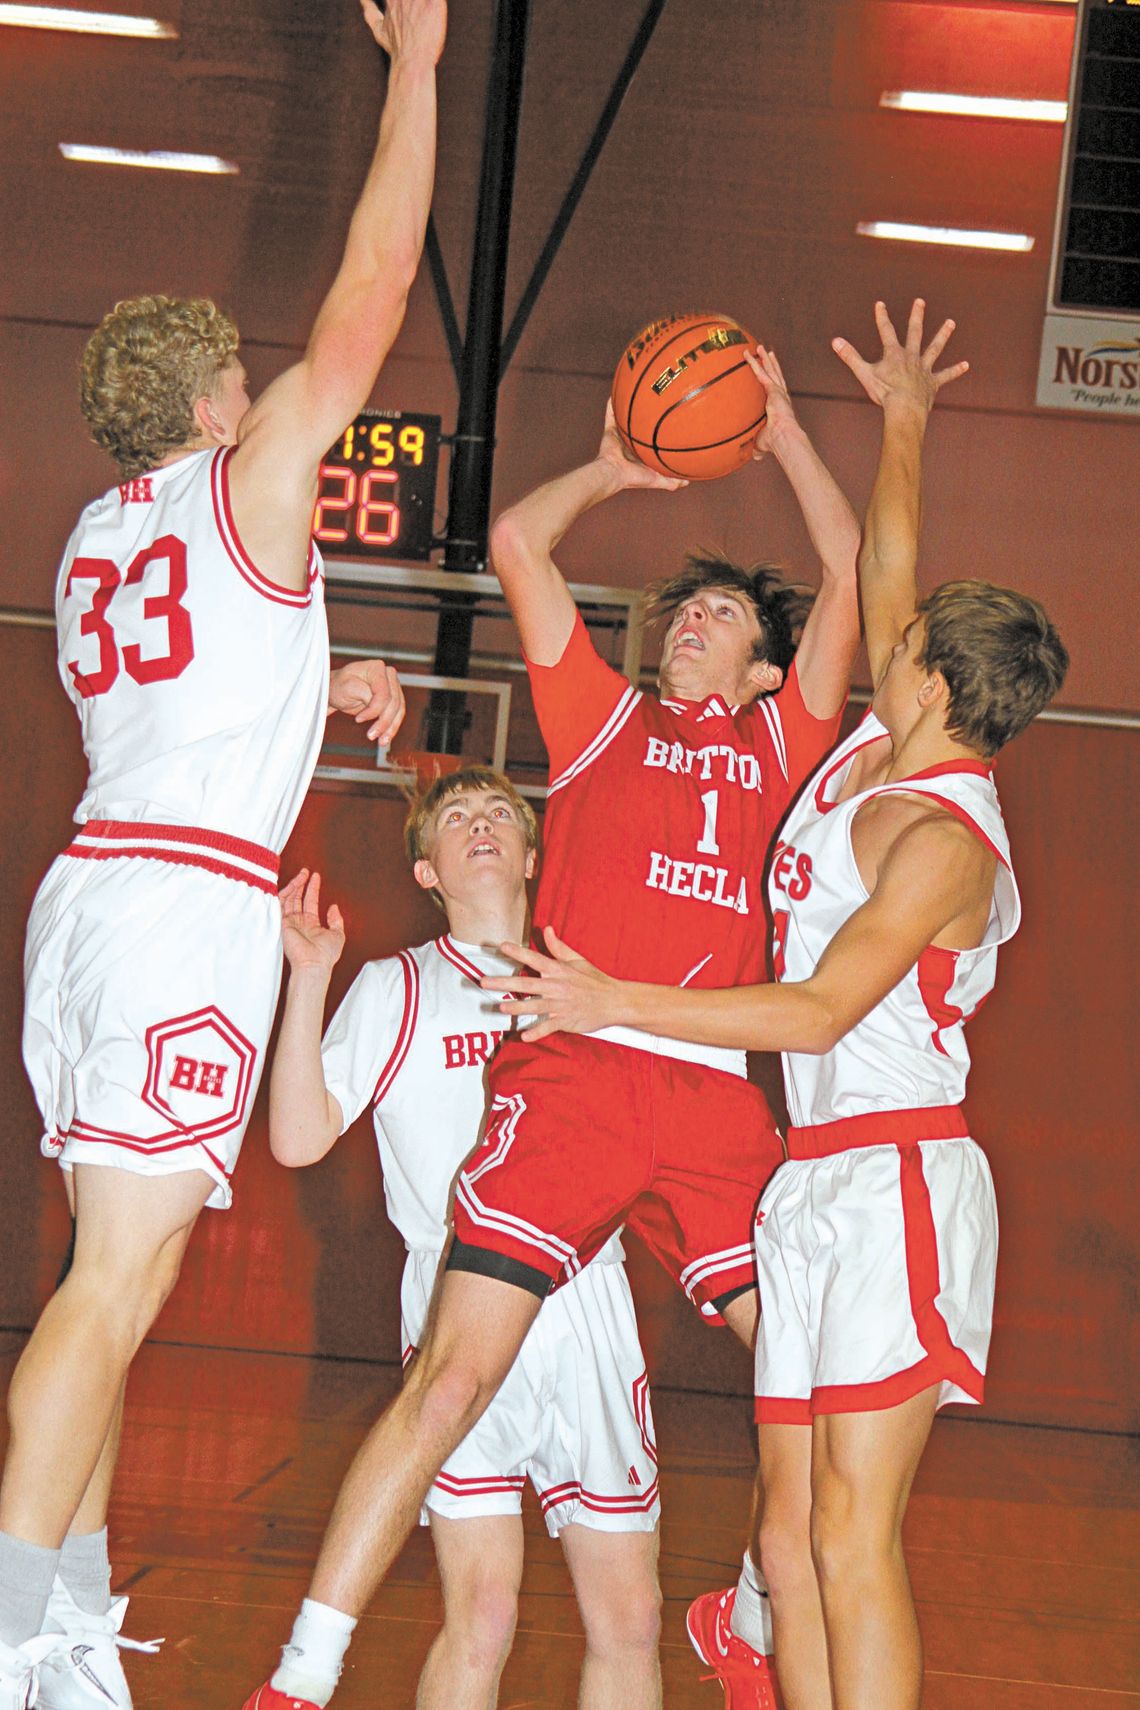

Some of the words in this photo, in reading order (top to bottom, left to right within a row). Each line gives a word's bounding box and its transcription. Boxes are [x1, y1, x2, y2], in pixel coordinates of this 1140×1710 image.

[312, 466, 399, 546] 26
[65, 534, 195, 699] 33
[697, 790, 719, 856] 1
[645, 851, 749, 915] HECLA
[169, 1055, 229, 1098] BH
[442, 1030, 507, 1069] BRI
